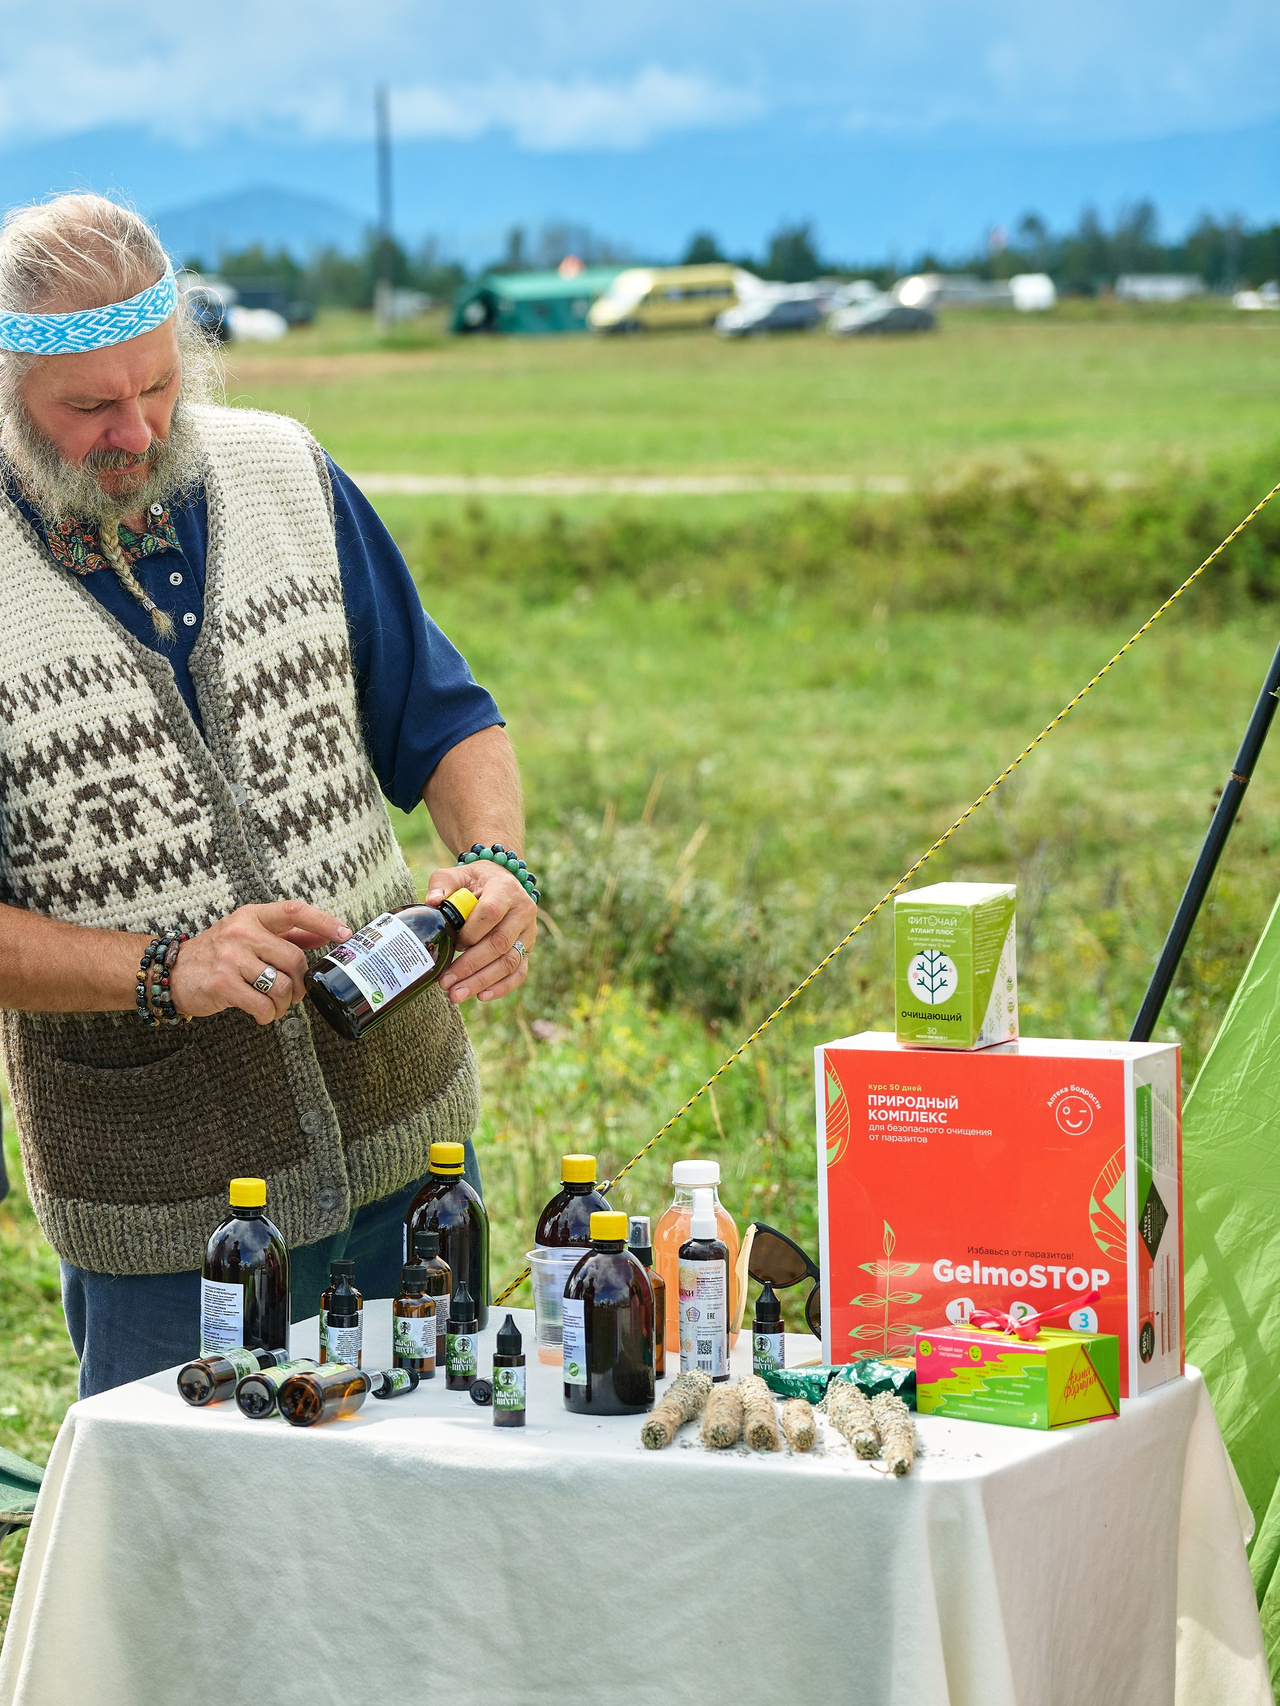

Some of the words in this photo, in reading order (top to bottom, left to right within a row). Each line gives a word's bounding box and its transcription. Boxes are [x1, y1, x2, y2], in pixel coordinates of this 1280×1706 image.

[910, 927, 935, 935] АТЛАНТ
[935, 928, 955, 936] ПЛЮС
[901, 1010, 962, 1022] очищающий
[926, 1026, 938, 1035] 30
[868, 1083, 888, 1092] курс
[867, 1094, 959, 1110] ПРИРОДНЫЙ
[1046, 1086, 1069, 1108] Аптека
[1069, 1084, 1102, 1110] Бодрости
[867, 1109, 948, 1124] КОМПЛЕКС
[868, 1124, 885, 1132] для
[886, 1123, 945, 1135] безопасного
[946, 1127, 993, 1137] очищения
[881, 1133, 928, 1144] паразитов
[967, 1246, 1009, 1256] Избавься
[1011, 1249, 1022, 1257] от
[1024, 1250, 1074, 1260] паразитов!
[932, 1258, 1111, 1292] GelmoSTOP
[956, 1301, 966, 1319] 1
[1078, 1312, 1090, 1328] 3
